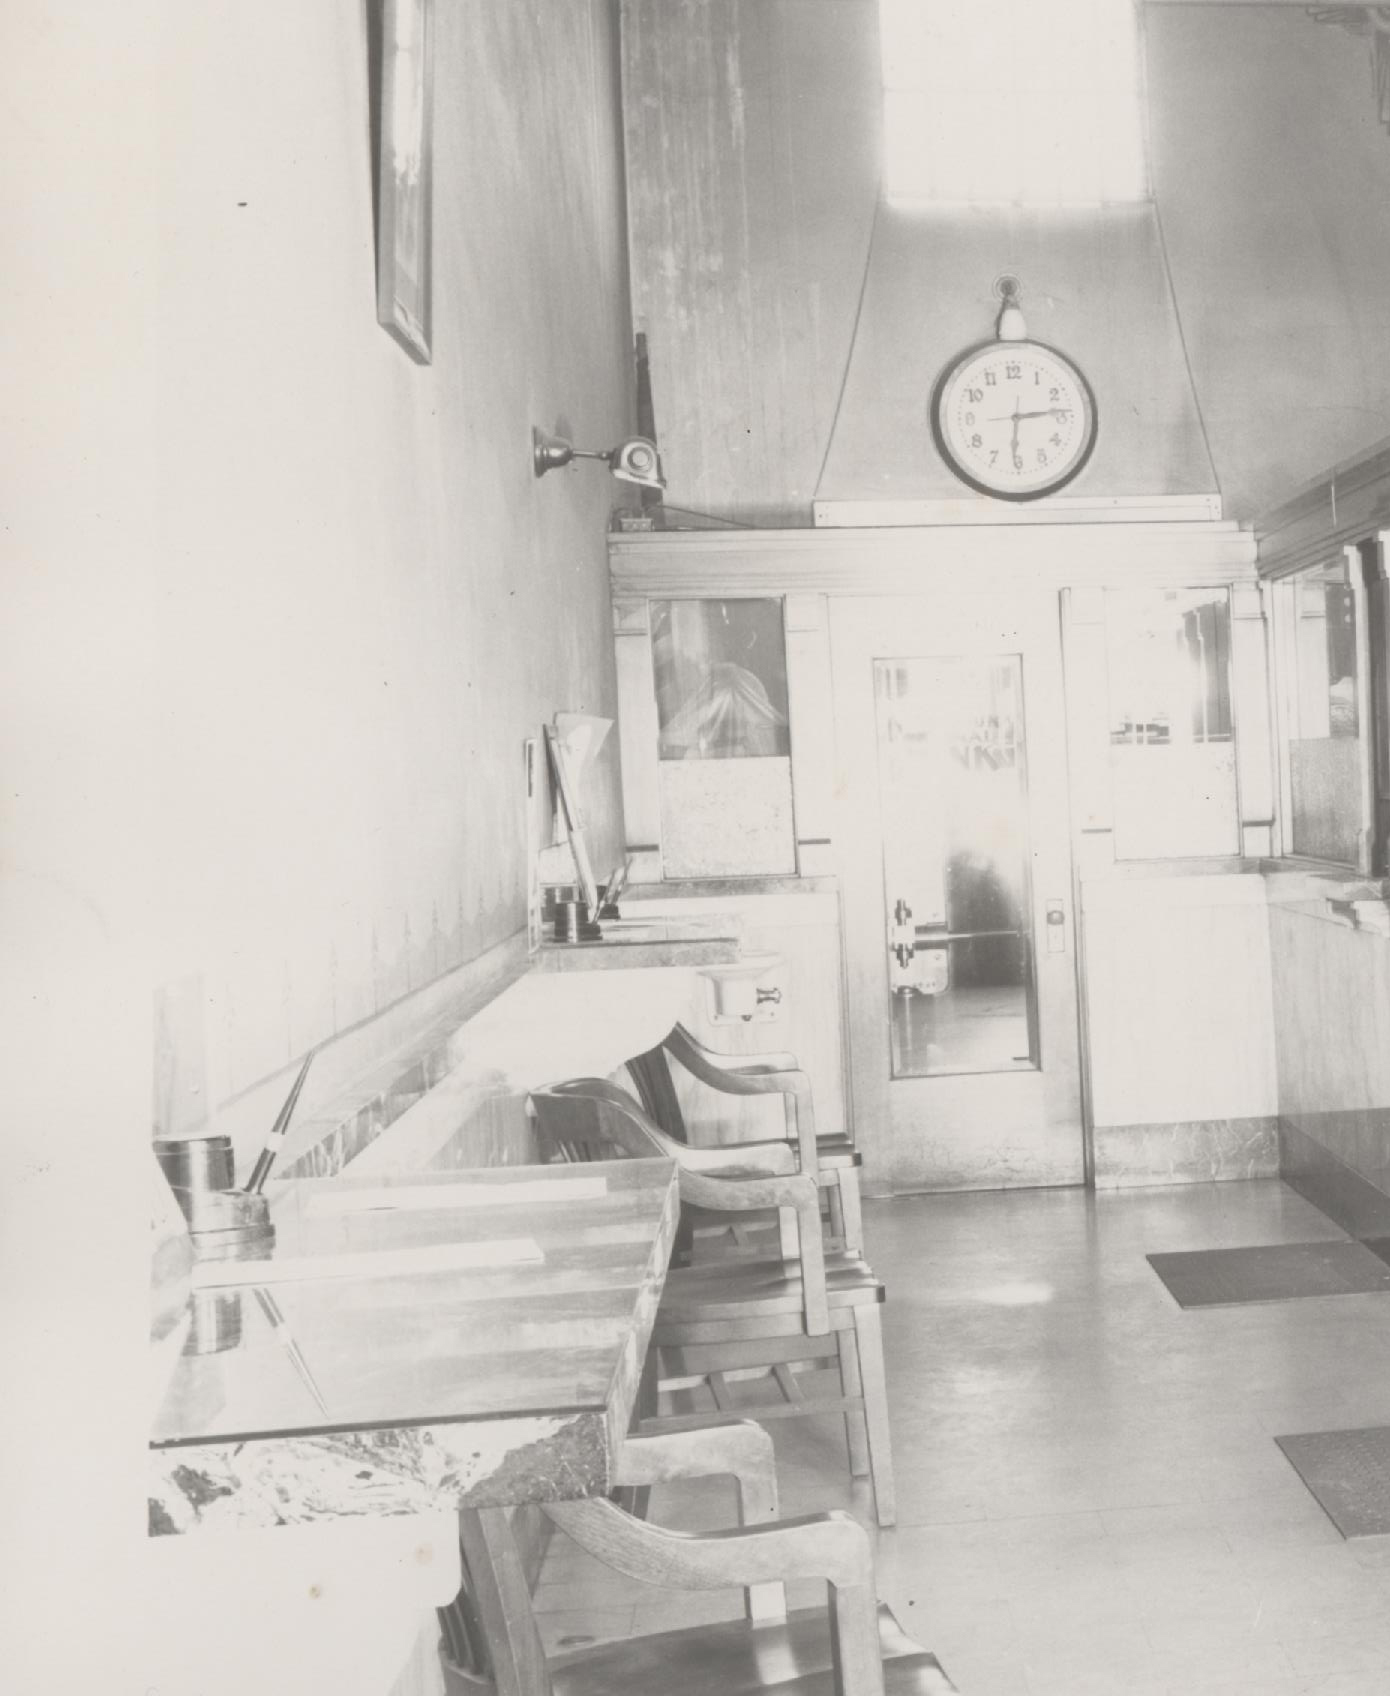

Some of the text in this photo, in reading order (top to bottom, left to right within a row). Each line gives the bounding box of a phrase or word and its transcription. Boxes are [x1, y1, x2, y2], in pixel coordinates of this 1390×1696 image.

[984, 371, 997, 386] 11
[1005, 365, 1022, 380] 12
[1034, 371, 1040, 386] 1
[968, 388, 983, 402] 10
[1049, 388, 1060, 401] 2
[971, 434, 982, 448] 8
[1049, 433, 1061, 447] 4
[990, 450, 999, 464] 7
[1014, 455, 1023, 470] 6
[1037, 448, 1047, 463] 5
